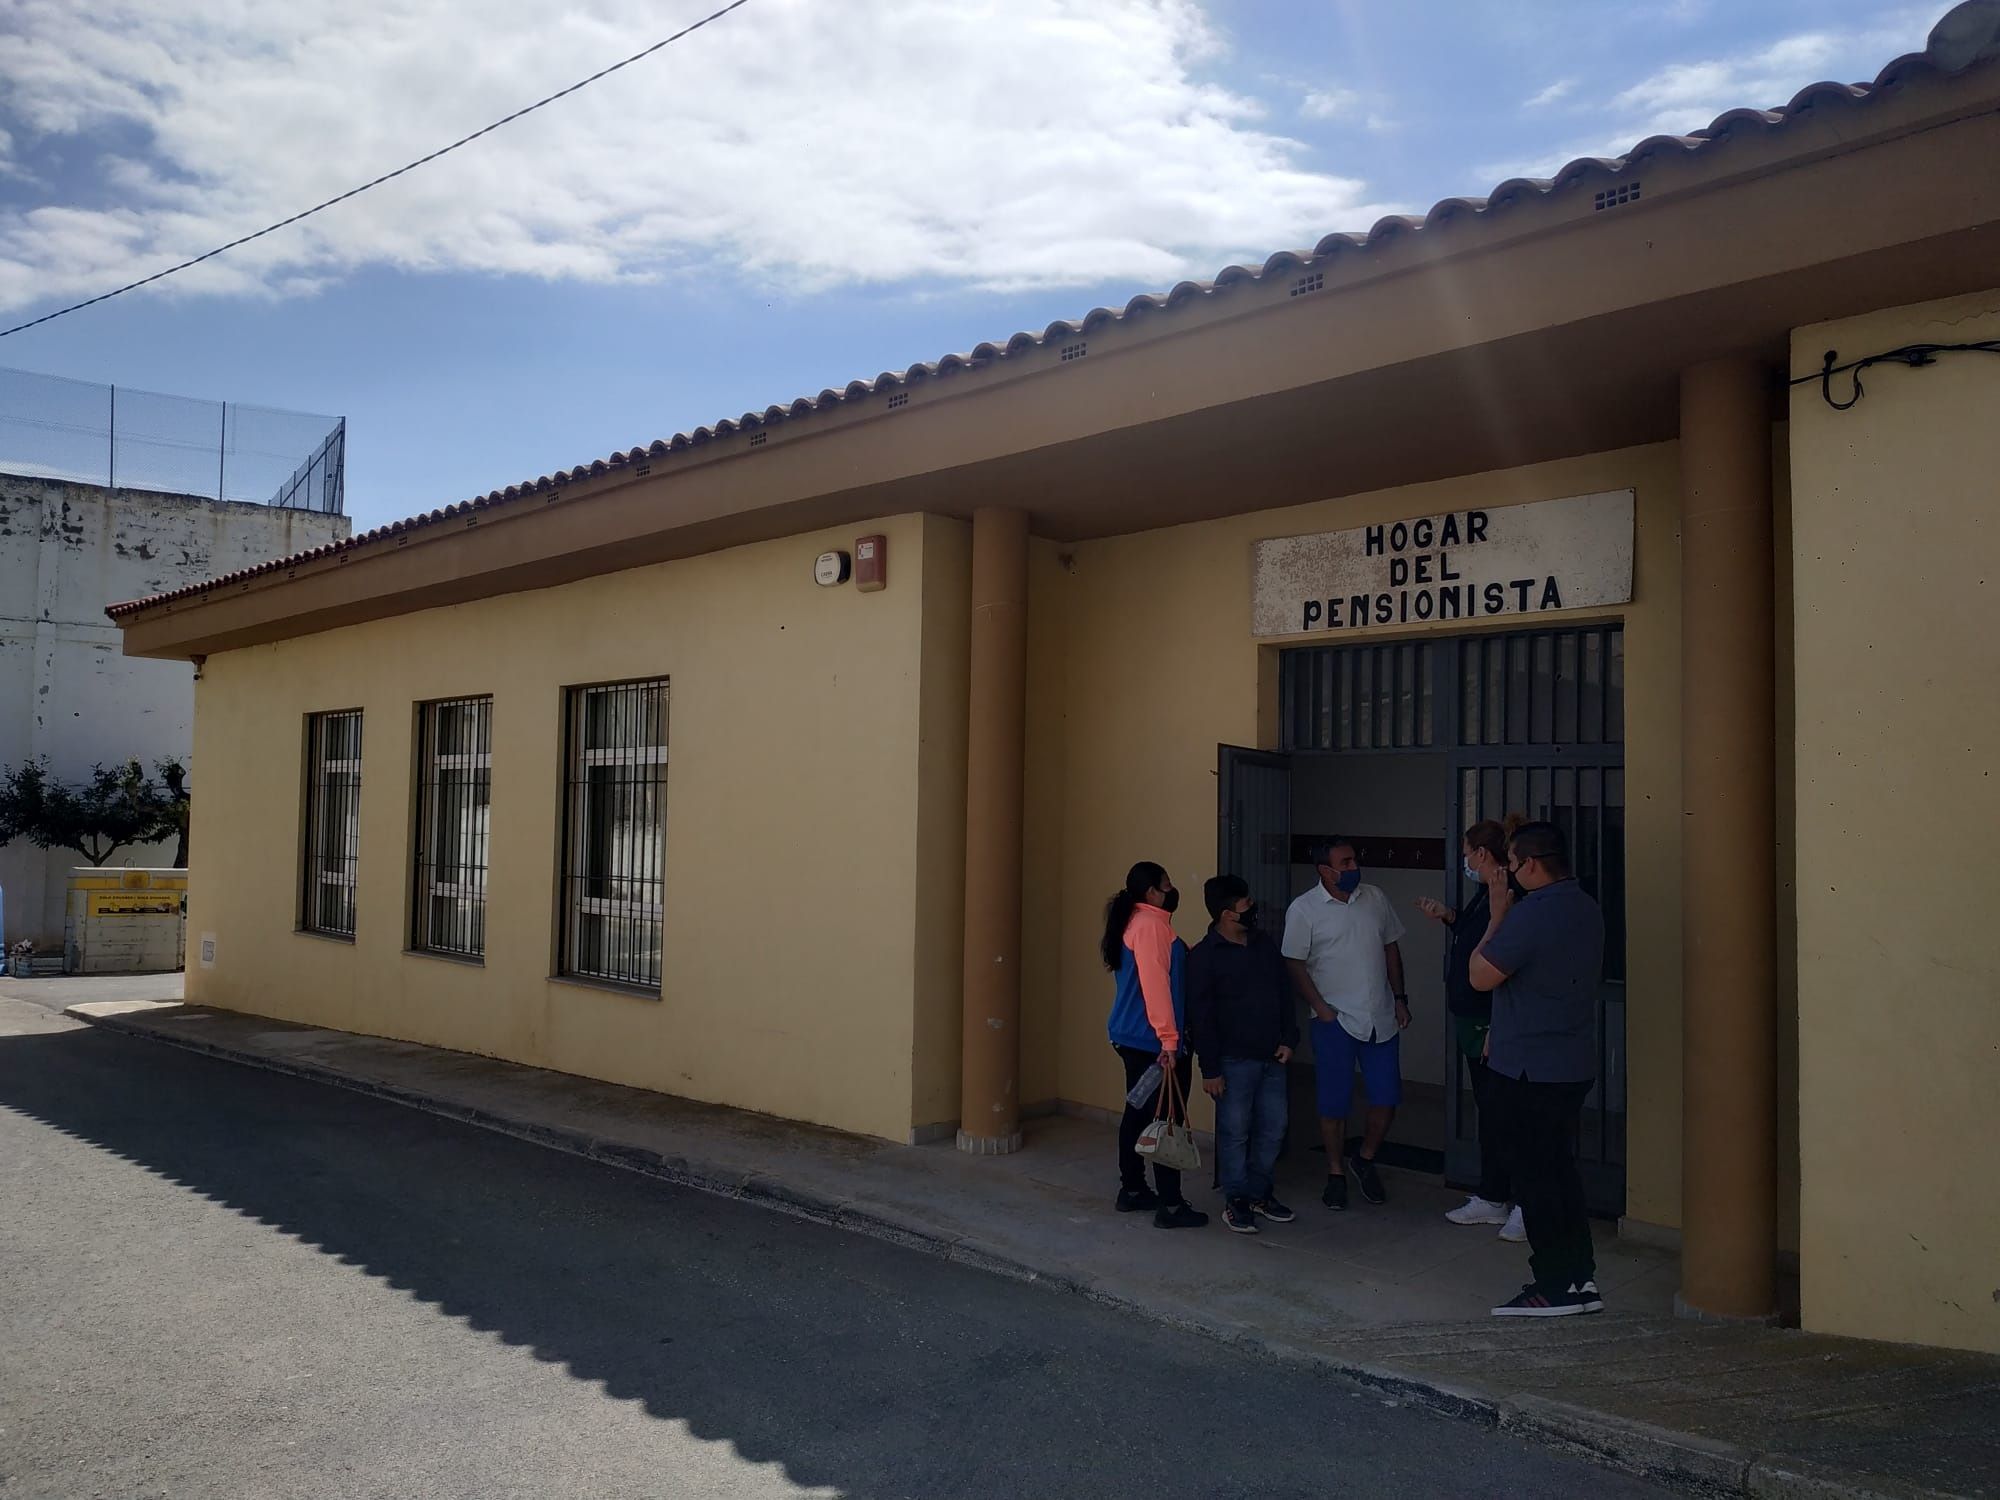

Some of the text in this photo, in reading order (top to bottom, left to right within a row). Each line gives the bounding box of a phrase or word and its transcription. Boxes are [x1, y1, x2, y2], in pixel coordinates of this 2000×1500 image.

[1366, 511, 1489, 556] HOGAR
[1390, 553, 1460, 587] DEL
[1303, 576, 1562, 630] PENSIONISTA
